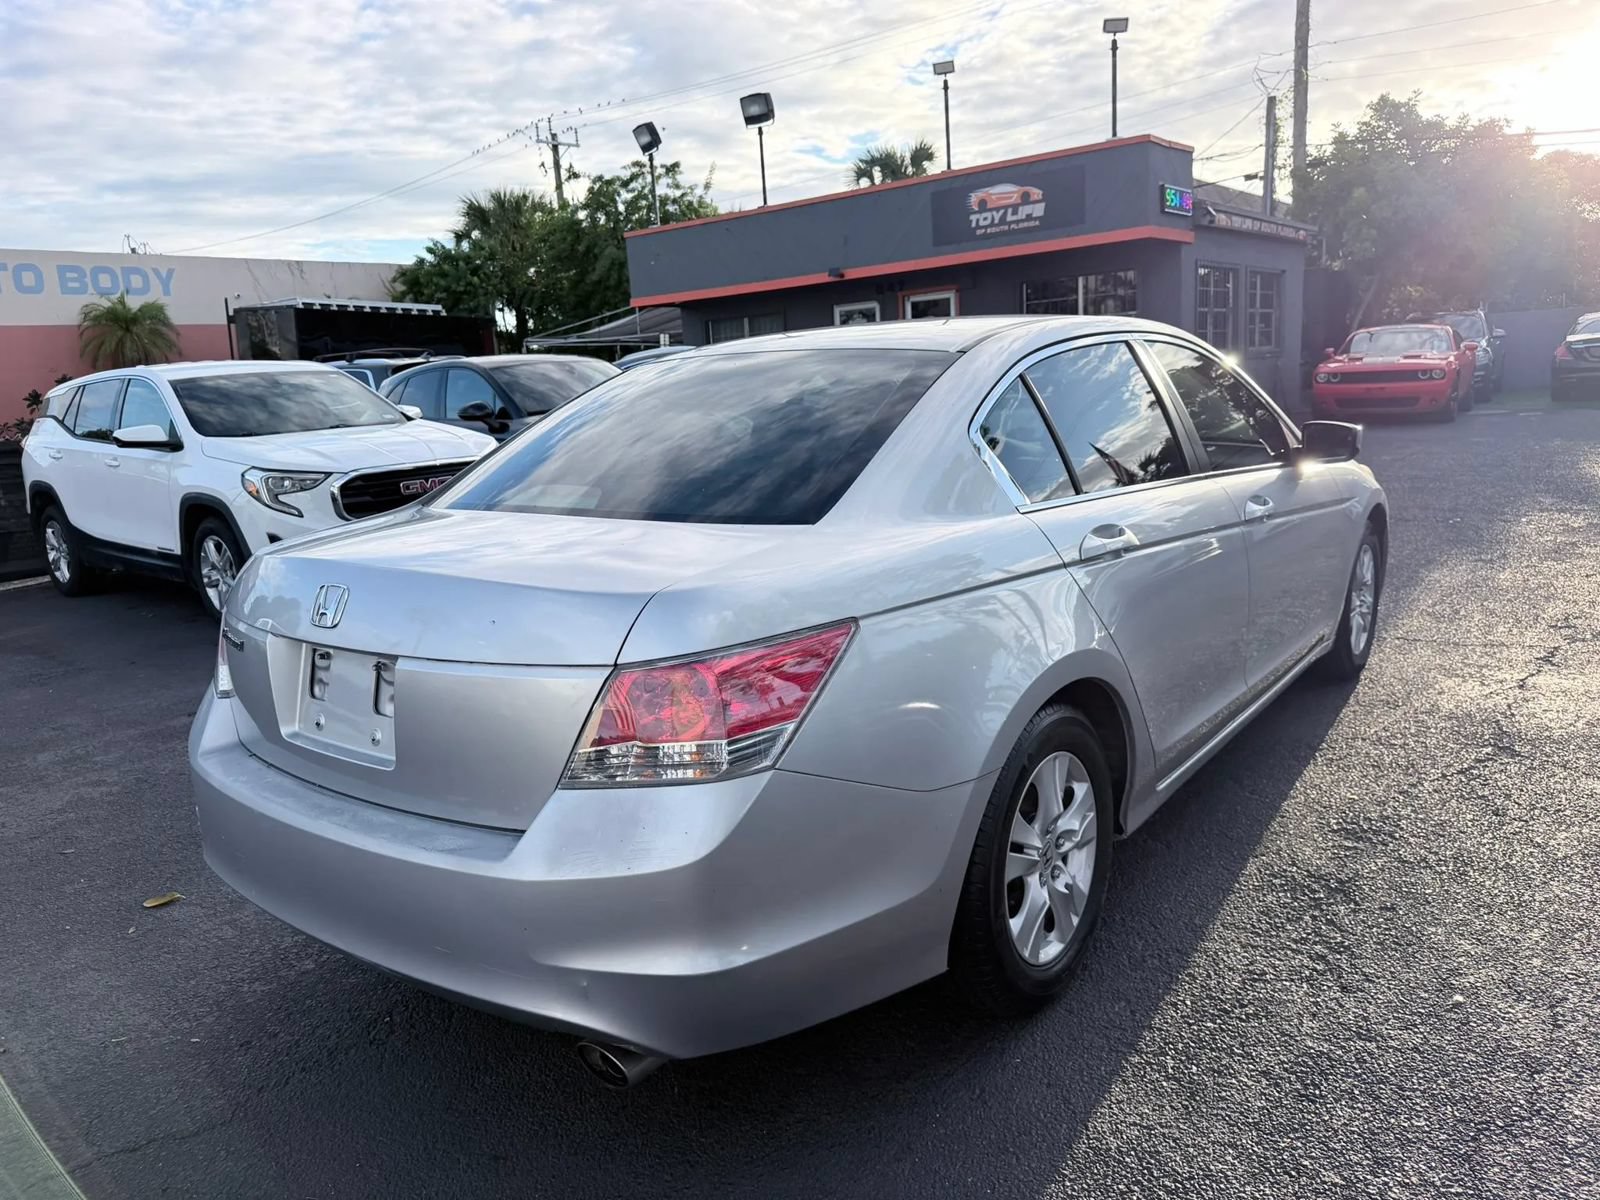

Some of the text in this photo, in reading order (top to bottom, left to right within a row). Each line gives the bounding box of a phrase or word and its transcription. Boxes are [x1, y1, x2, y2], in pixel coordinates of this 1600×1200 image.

[969, 202, 1046, 228] TOY LIFE
[986, 225, 1009, 233] SOUTH
[1010, 220, 1040, 230] FLORIDA
[56, 264, 175, 297] BODY
